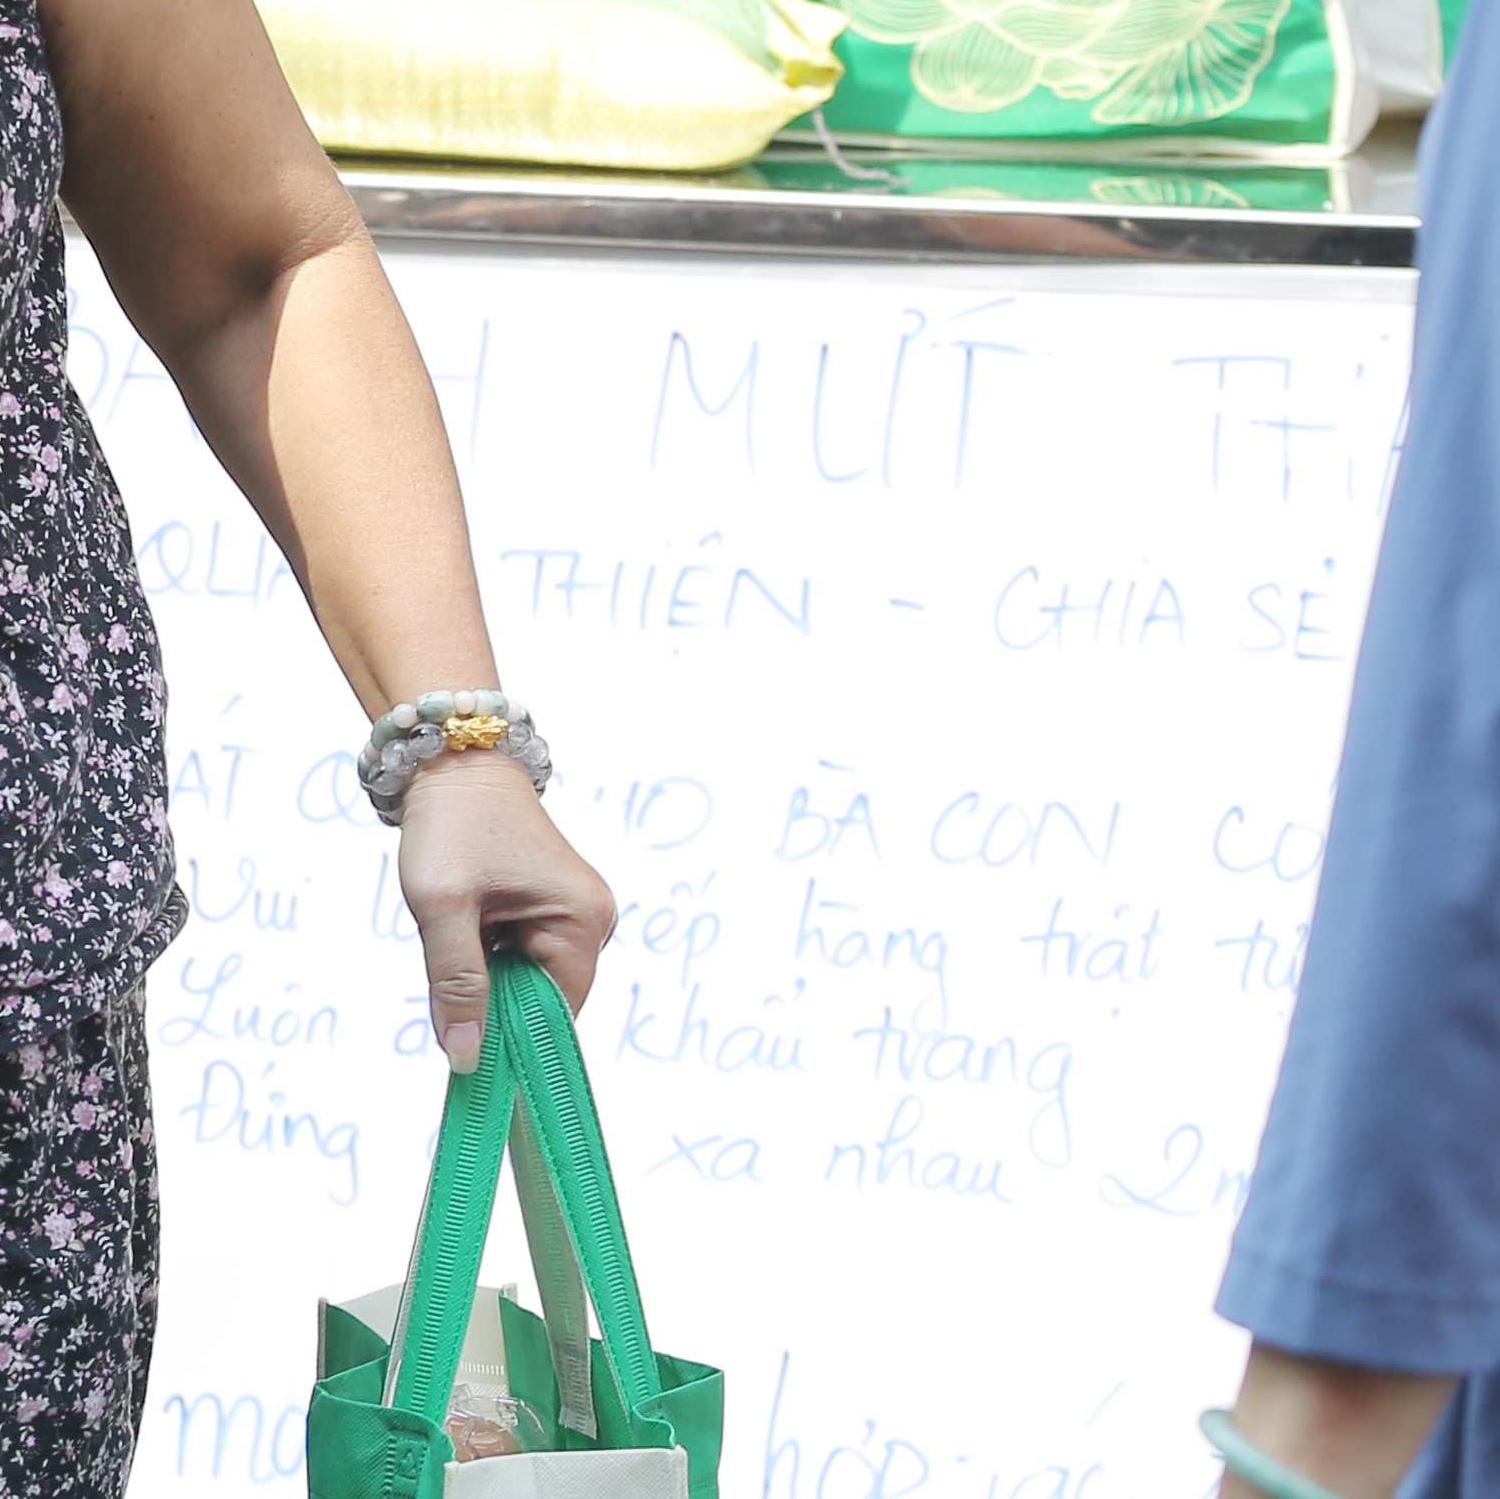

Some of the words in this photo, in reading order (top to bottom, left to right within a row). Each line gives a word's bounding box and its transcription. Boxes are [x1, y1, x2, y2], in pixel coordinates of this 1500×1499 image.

[498, 529, 813, 656] THIỆN
[773, 758, 882, 862] BÀ
[930, 790, 1122, 869] CON
[793, 876, 949, 1033] hàng
[1019, 897, 1164, 1019] trật
[644, 1132, 765, 1184] xa
[824, 1093, 1015, 1205] nhau
[851, 1006, 1074, 1168] trang
